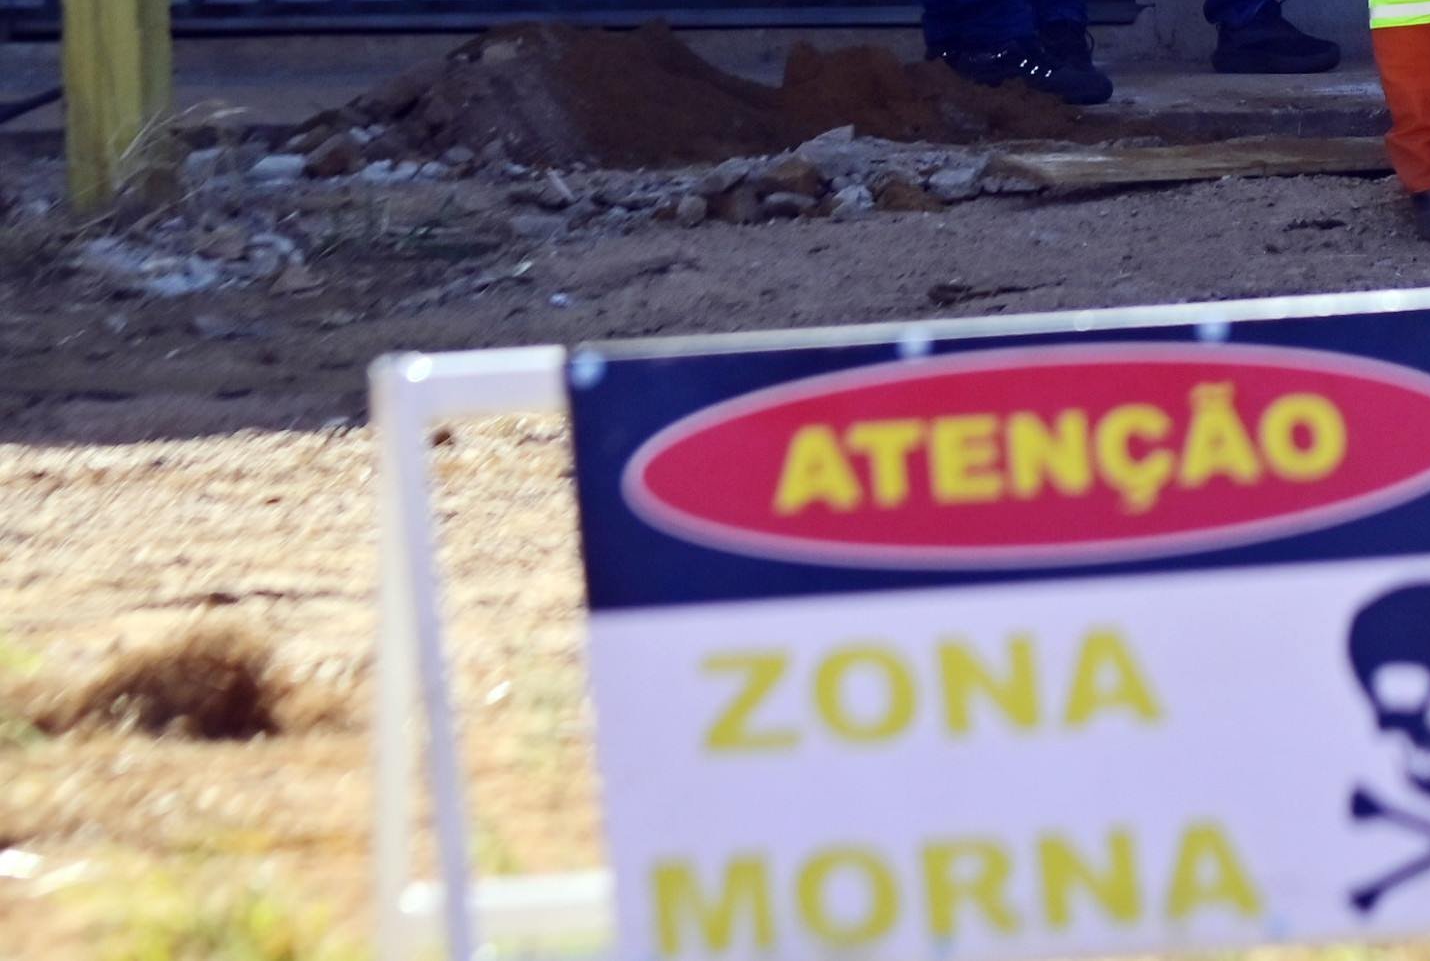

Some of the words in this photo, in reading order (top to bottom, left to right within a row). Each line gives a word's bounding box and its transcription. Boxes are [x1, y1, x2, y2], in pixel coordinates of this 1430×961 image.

[772, 383, 1348, 515] ATENÇÃO
[698, 626, 1166, 755] ZONA
[648, 819, 1264, 959] MORNA
